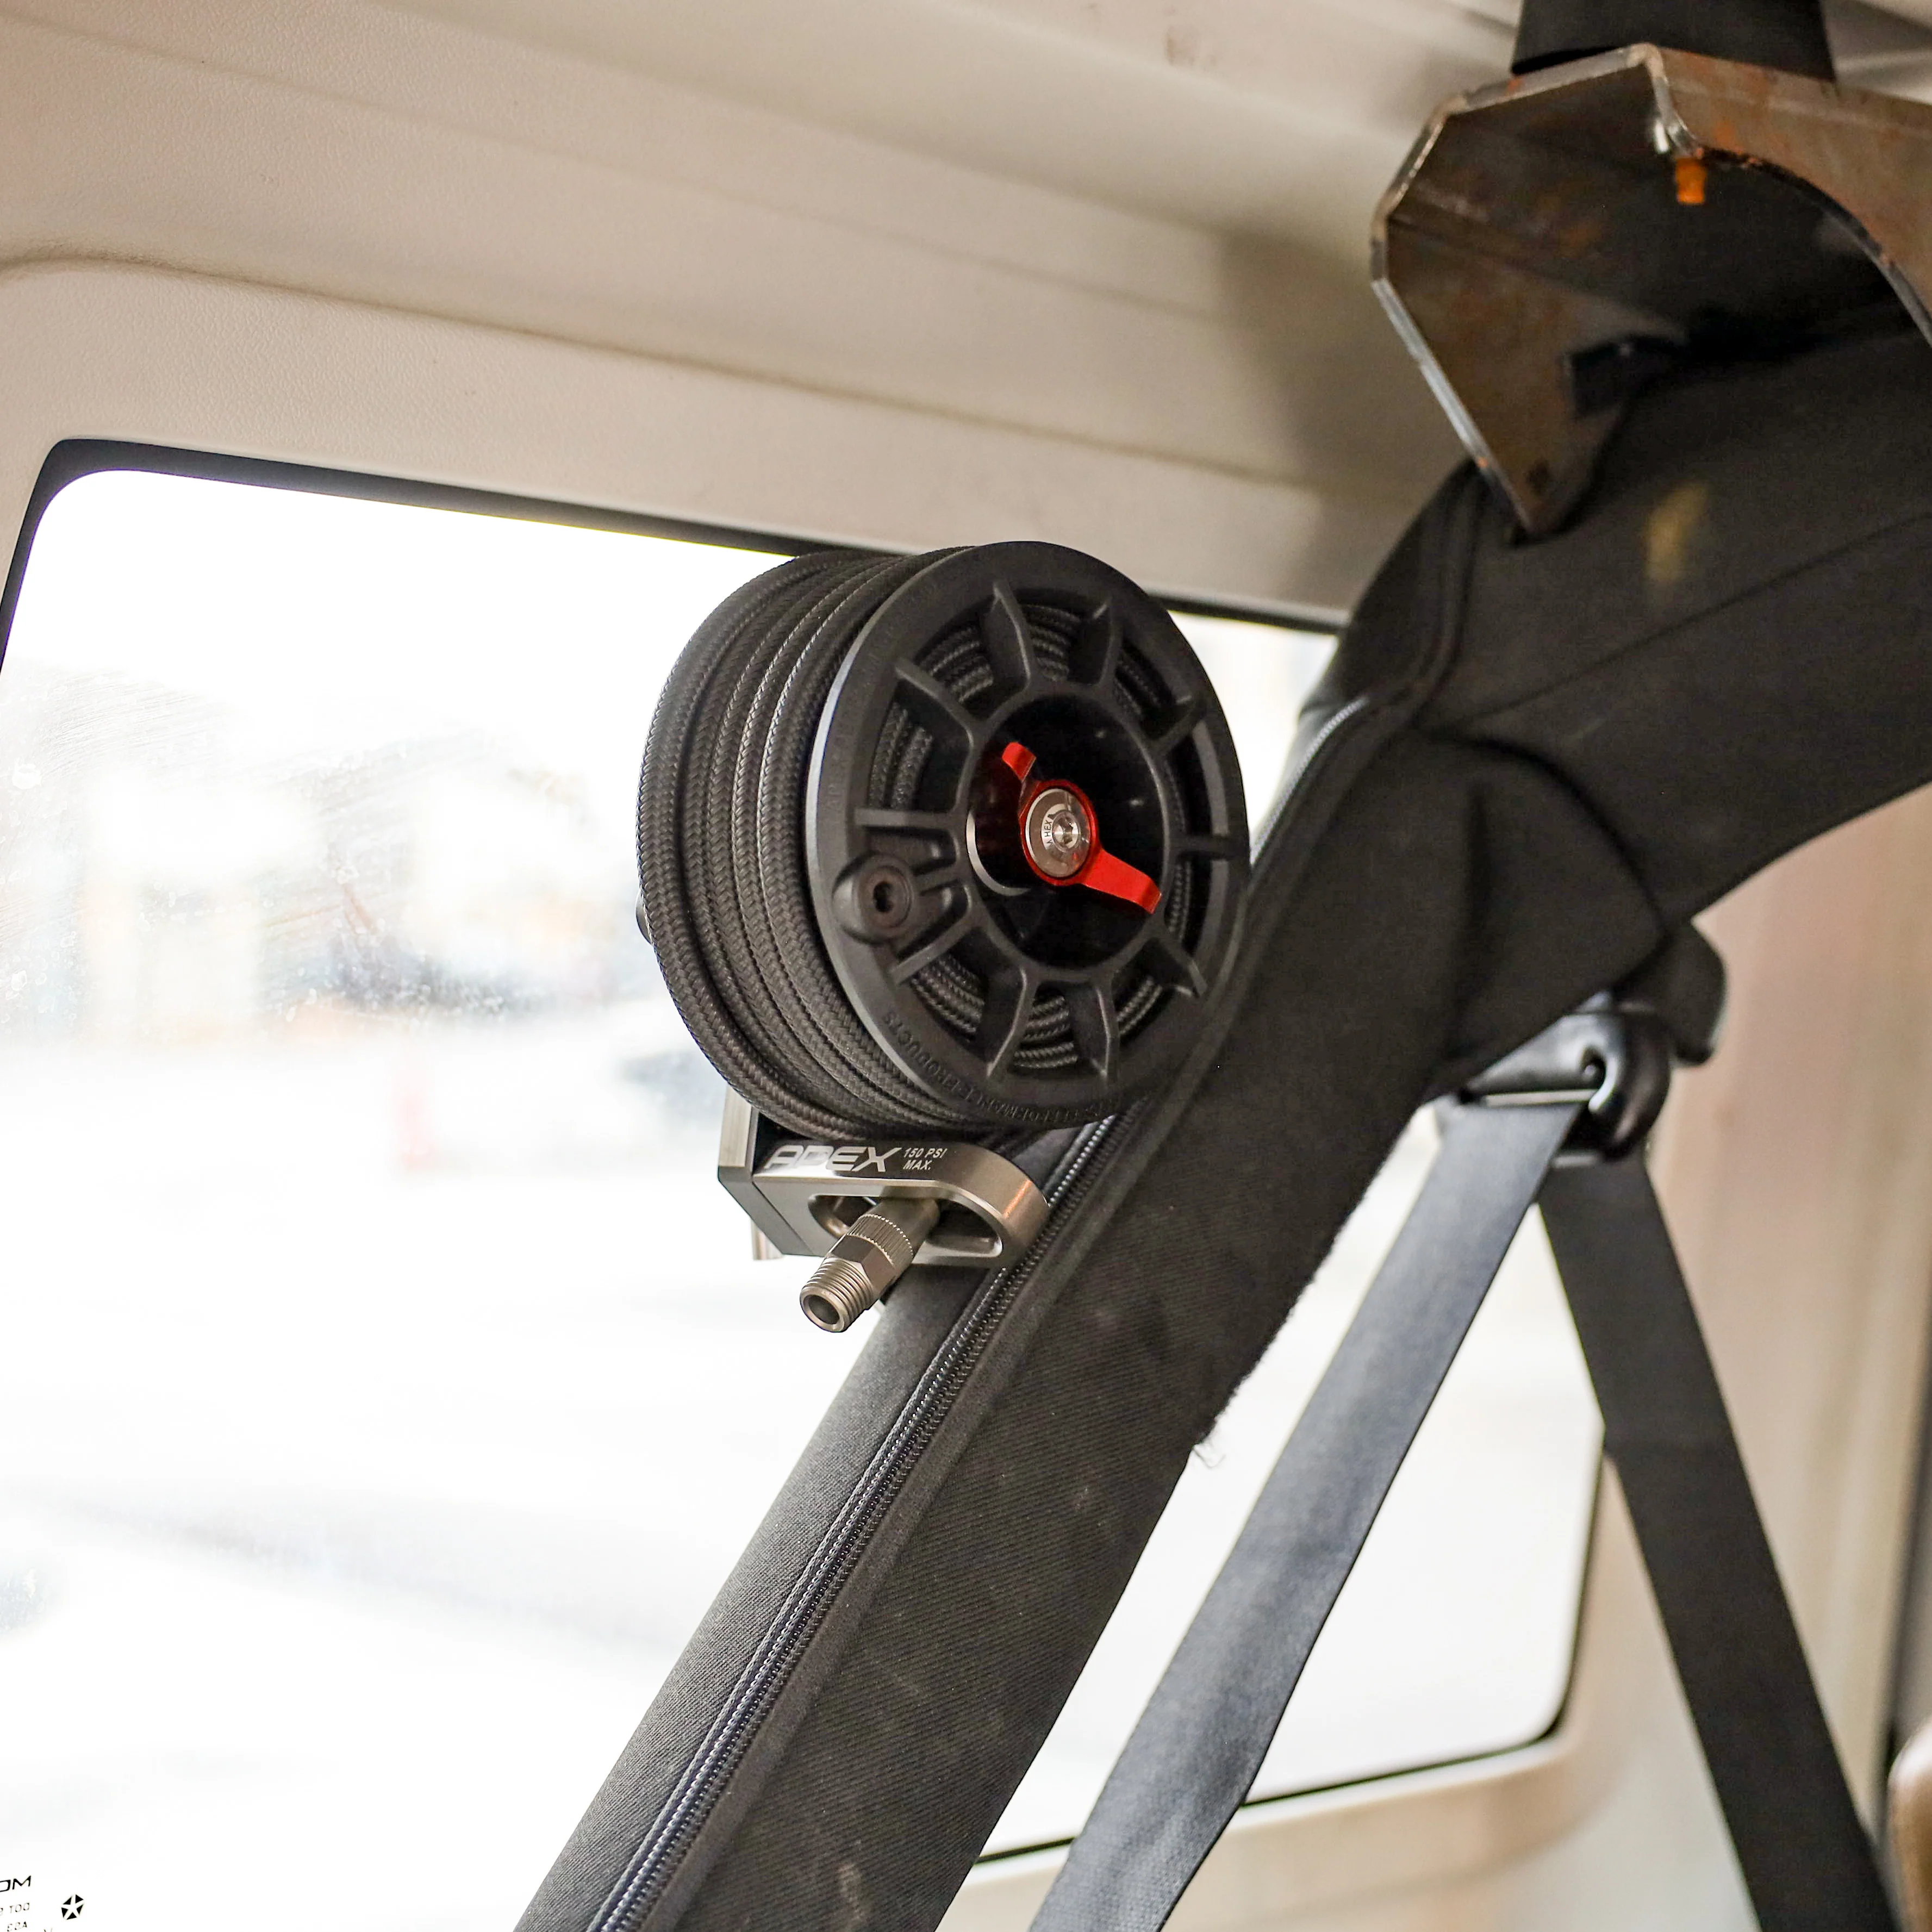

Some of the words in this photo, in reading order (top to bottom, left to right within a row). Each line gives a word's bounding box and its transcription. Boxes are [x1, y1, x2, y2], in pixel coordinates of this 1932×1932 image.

[1044, 820, 1052, 837] HEX
[884, 1011, 964, 1094] PRODUCTS
[764, 1144, 902, 1173] APEX
[903, 1147, 924, 1158] 150
[924, 1147, 948, 1159] PSI
[902, 1160, 932, 1170] MAX.
